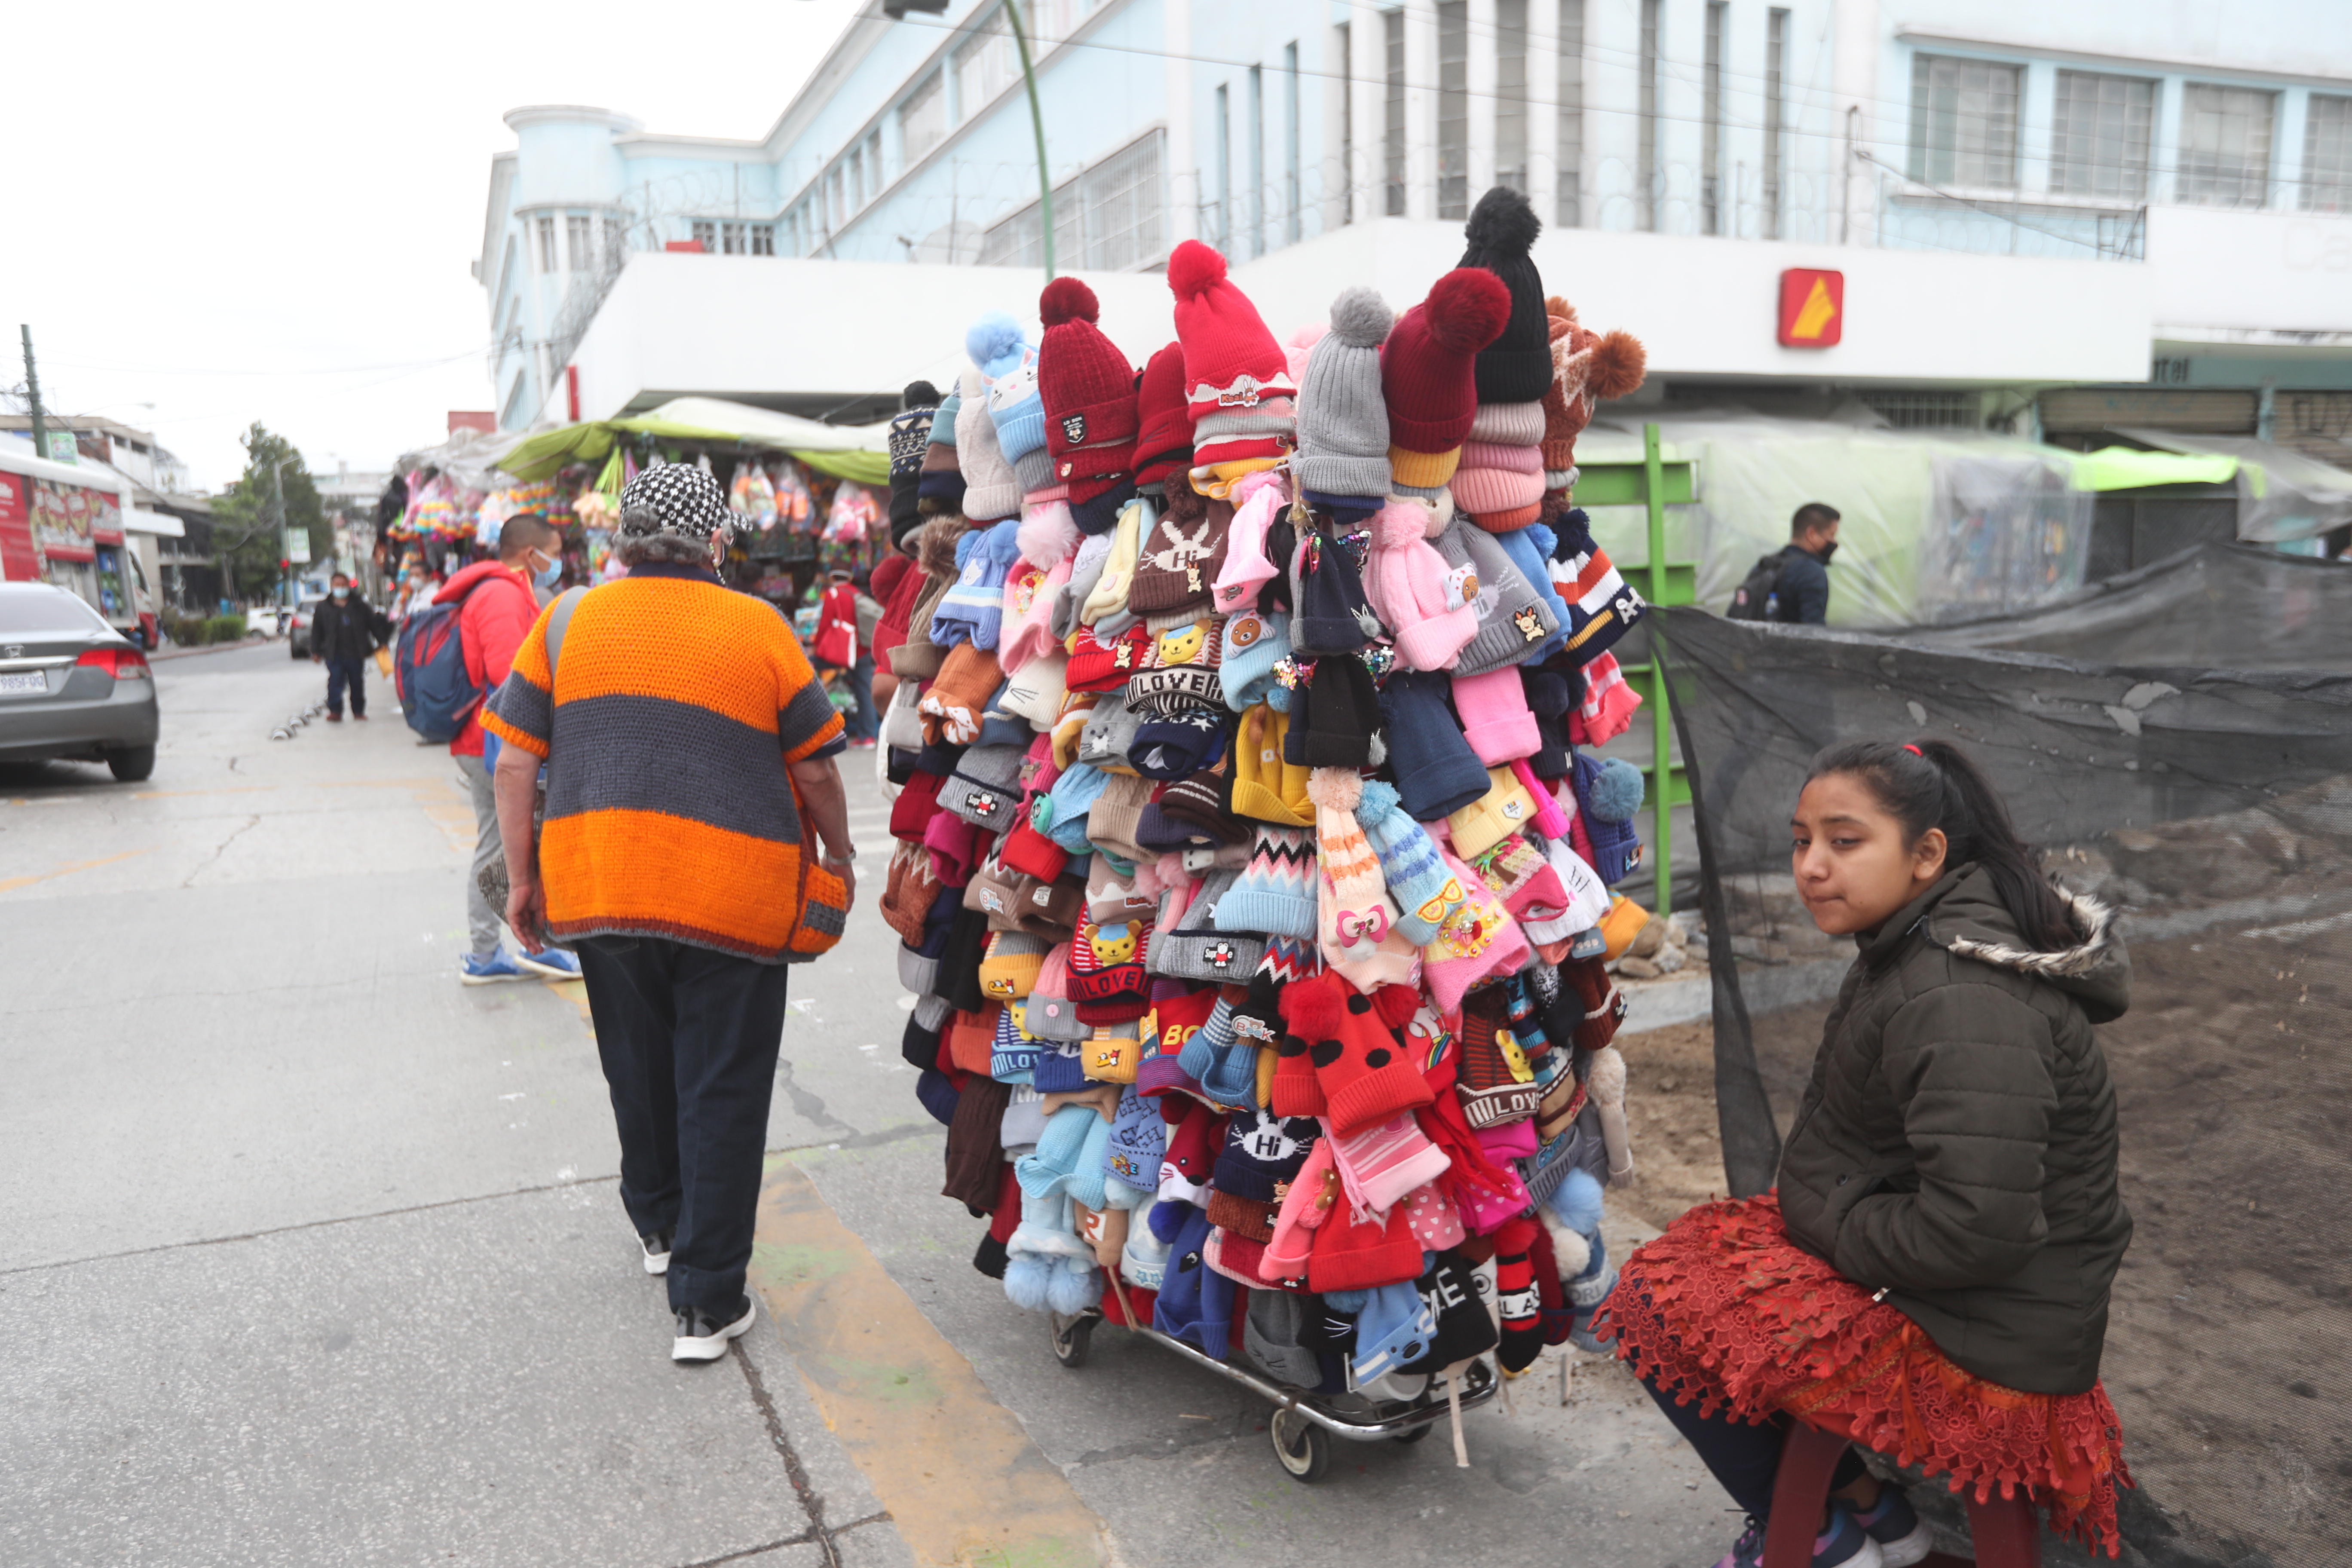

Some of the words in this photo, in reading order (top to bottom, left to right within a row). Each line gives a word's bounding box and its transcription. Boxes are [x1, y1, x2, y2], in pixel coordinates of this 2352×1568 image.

[1172, 550, 1198, 569] Hi
[1139, 672, 1205, 695] LOVE
[1084, 971, 1138, 995] LOVE
[1162, 1021, 1202, 1045] BO
[1494, 1091, 1537, 1115] LOV
[1255, 1134, 1281, 1156] Hi
